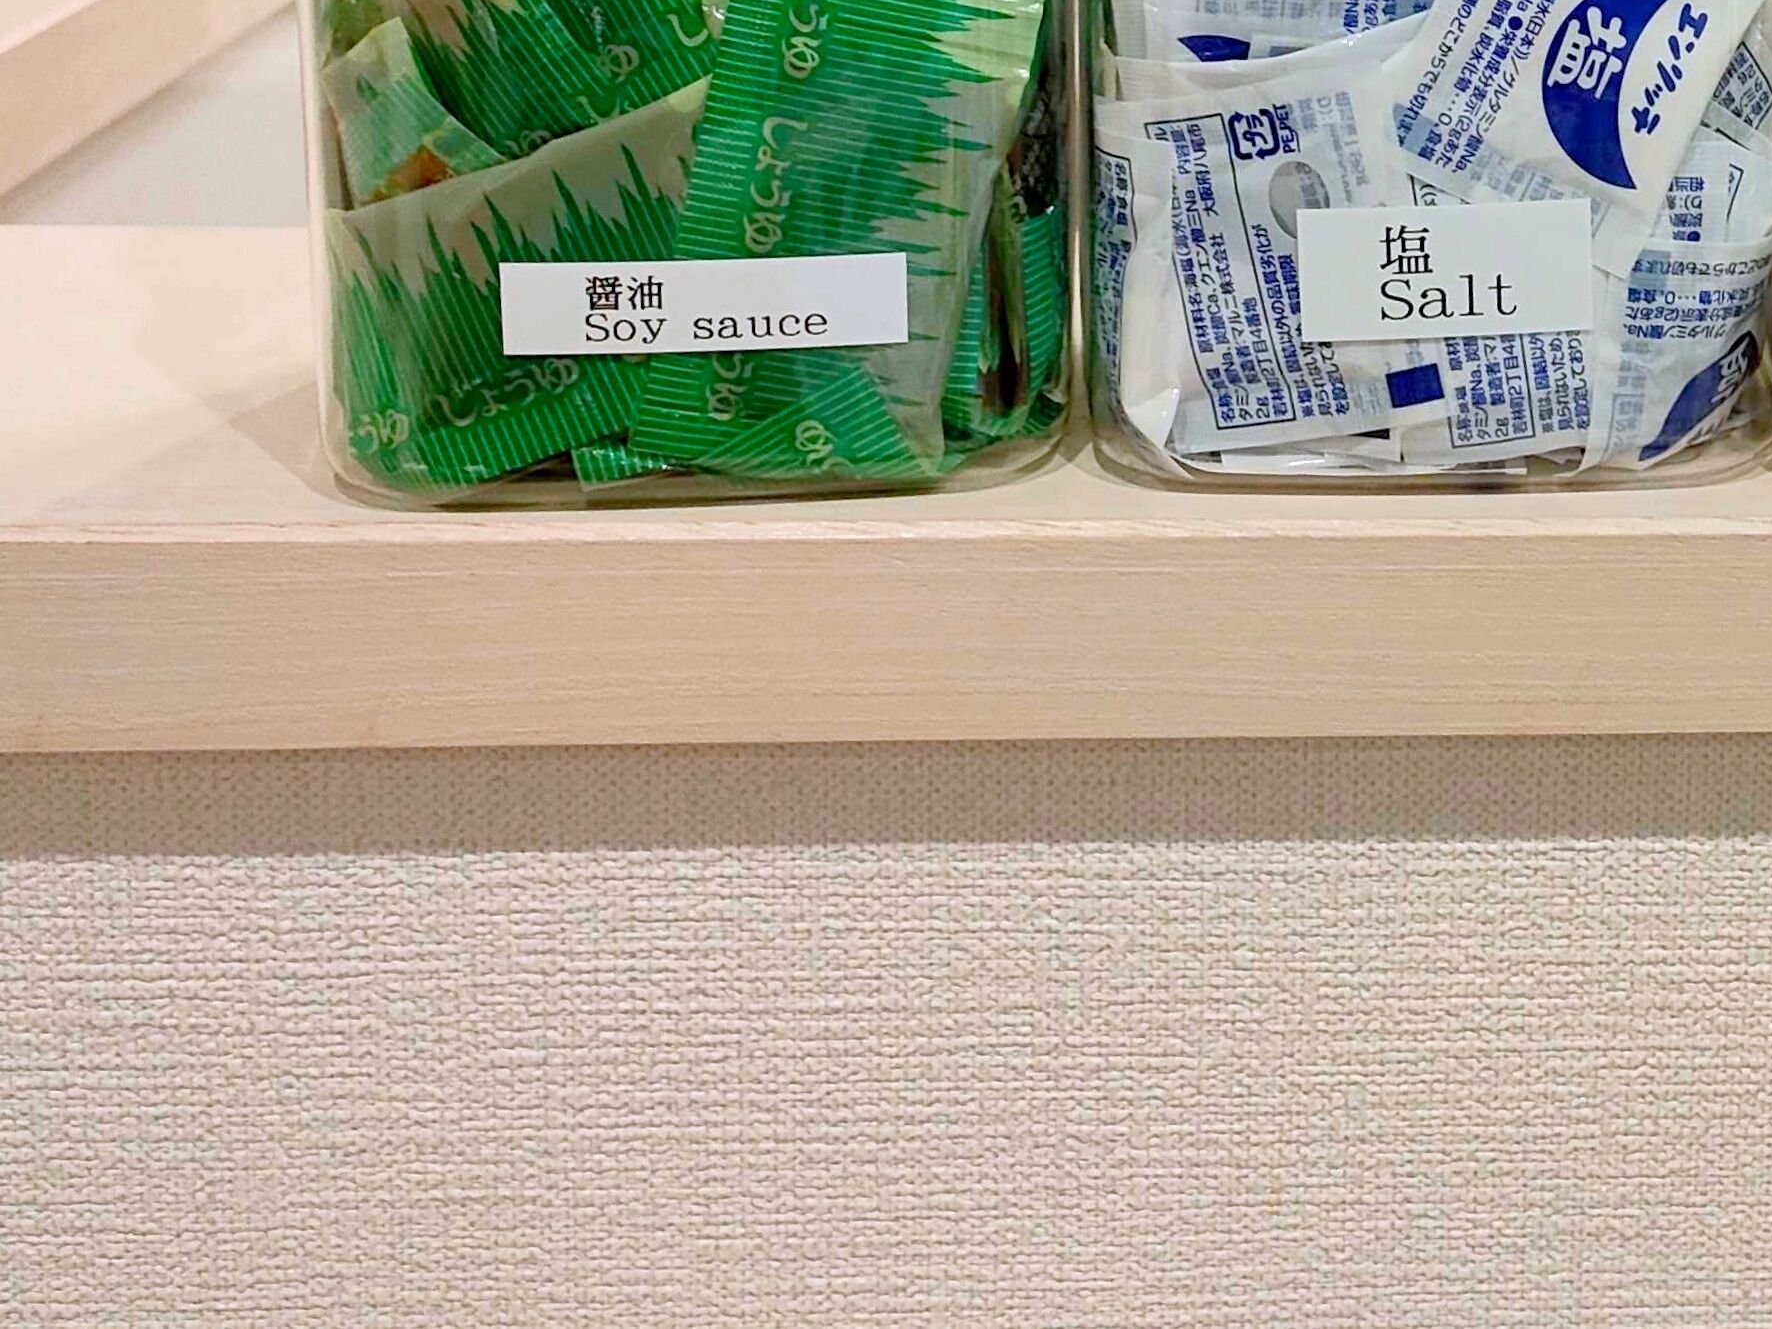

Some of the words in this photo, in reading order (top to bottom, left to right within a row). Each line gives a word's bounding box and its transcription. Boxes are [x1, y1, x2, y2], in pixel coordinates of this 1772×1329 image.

[1547, 6, 1627, 100] 塩
[742, 116, 811, 254] しょうゆ
[1379, 224, 1433, 275] 塩
[585, 275, 664, 311] 醤油
[1380, 273, 1517, 321] Salt
[585, 312, 668, 344] Soy
[692, 311, 829, 340] sauce
